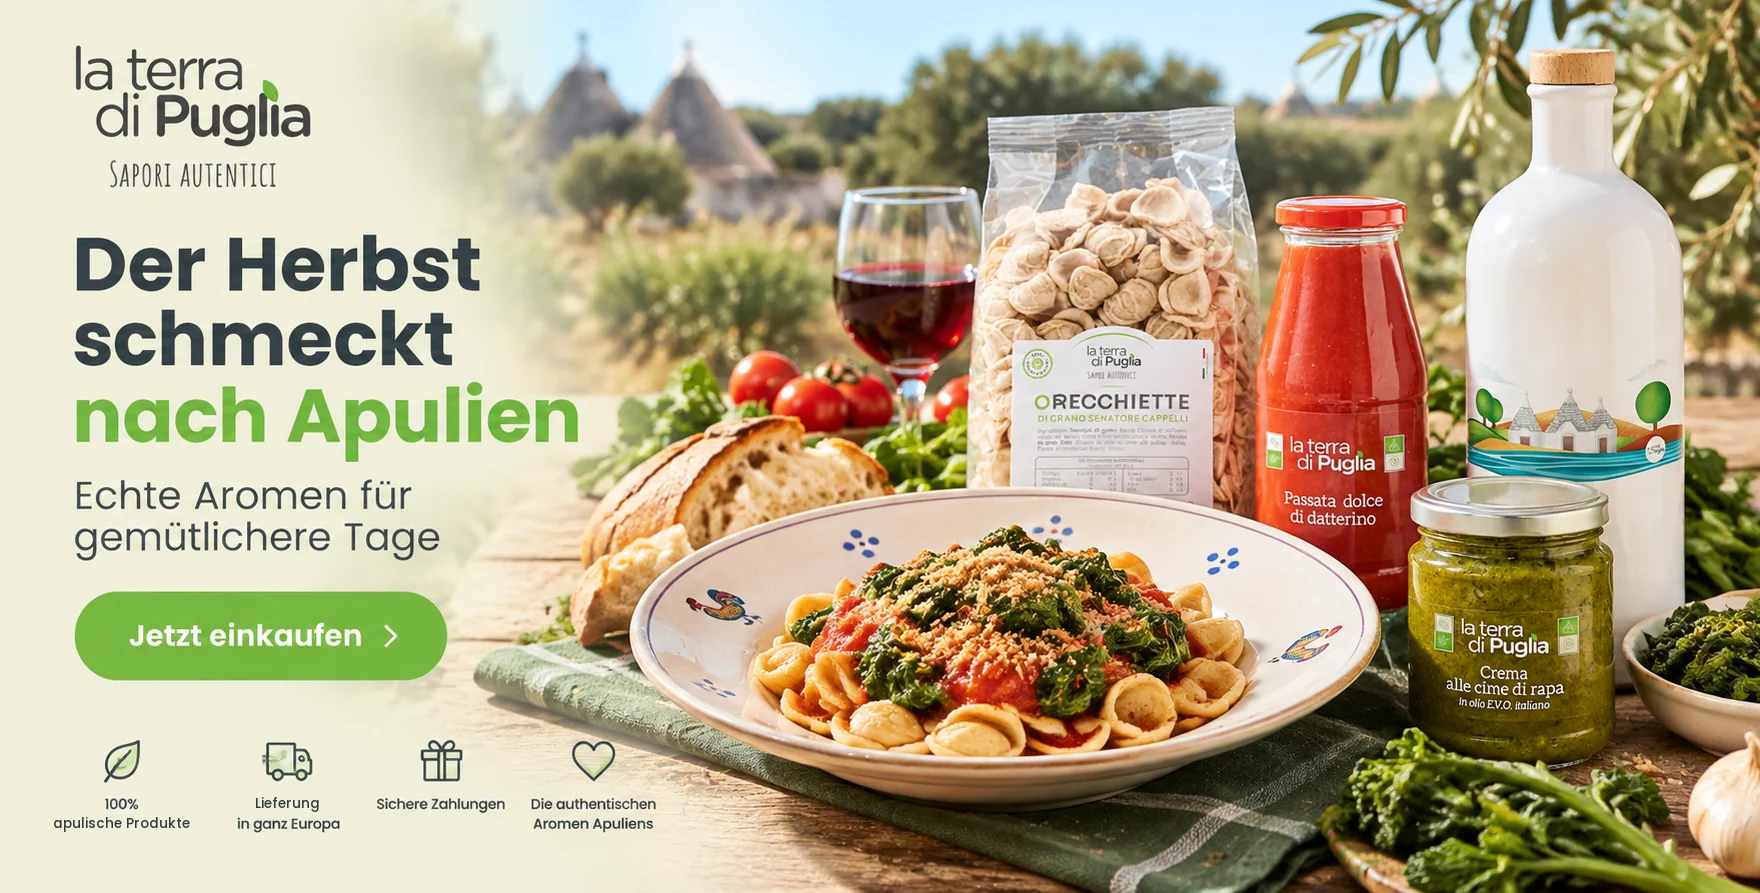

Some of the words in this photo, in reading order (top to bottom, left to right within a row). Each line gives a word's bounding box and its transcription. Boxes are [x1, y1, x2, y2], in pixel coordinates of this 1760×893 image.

[1086, 345, 1097, 356] la
[1099, 346, 1127, 356] terra
[1091, 356, 1103, 367] di
[1105, 355, 1142, 369] Puglia
[1034, 393, 1190, 410] ORECCHIETTE
[1037, 415, 1049, 423] DI
[1050, 415, 1087, 423] GRANO
[1088, 415, 1140, 423] SENATORE
[1142, 415, 1189, 423] CAPPELLI
[1290, 436, 1304, 453] la
[1307, 439, 1350, 455] terra
[1297, 453, 1313, 471] di
[1318, 453, 1376, 475] Puglia
[1284, 490, 1337, 508] Passata
[1343, 494, 1384, 508] dolce
[1290, 509, 1304, 524] di
[1307, 511, 1377, 526] datterino
[1461, 618, 1475, 636] la
[1479, 621, 1524, 638] terra
[1468, 636, 1485, 654] di
[1490, 635, 1549, 658] Puglia
[1480, 665, 1528, 680] Crema
[1446, 677, 1471, 693] alle
[1474, 681, 1509, 695] cime
[1512, 682, 1527, 696] di
[1530, 683, 1565, 699] rapa
[1469, 698, 1486, 709] olio
[1515, 700, 1551, 711] italiano
